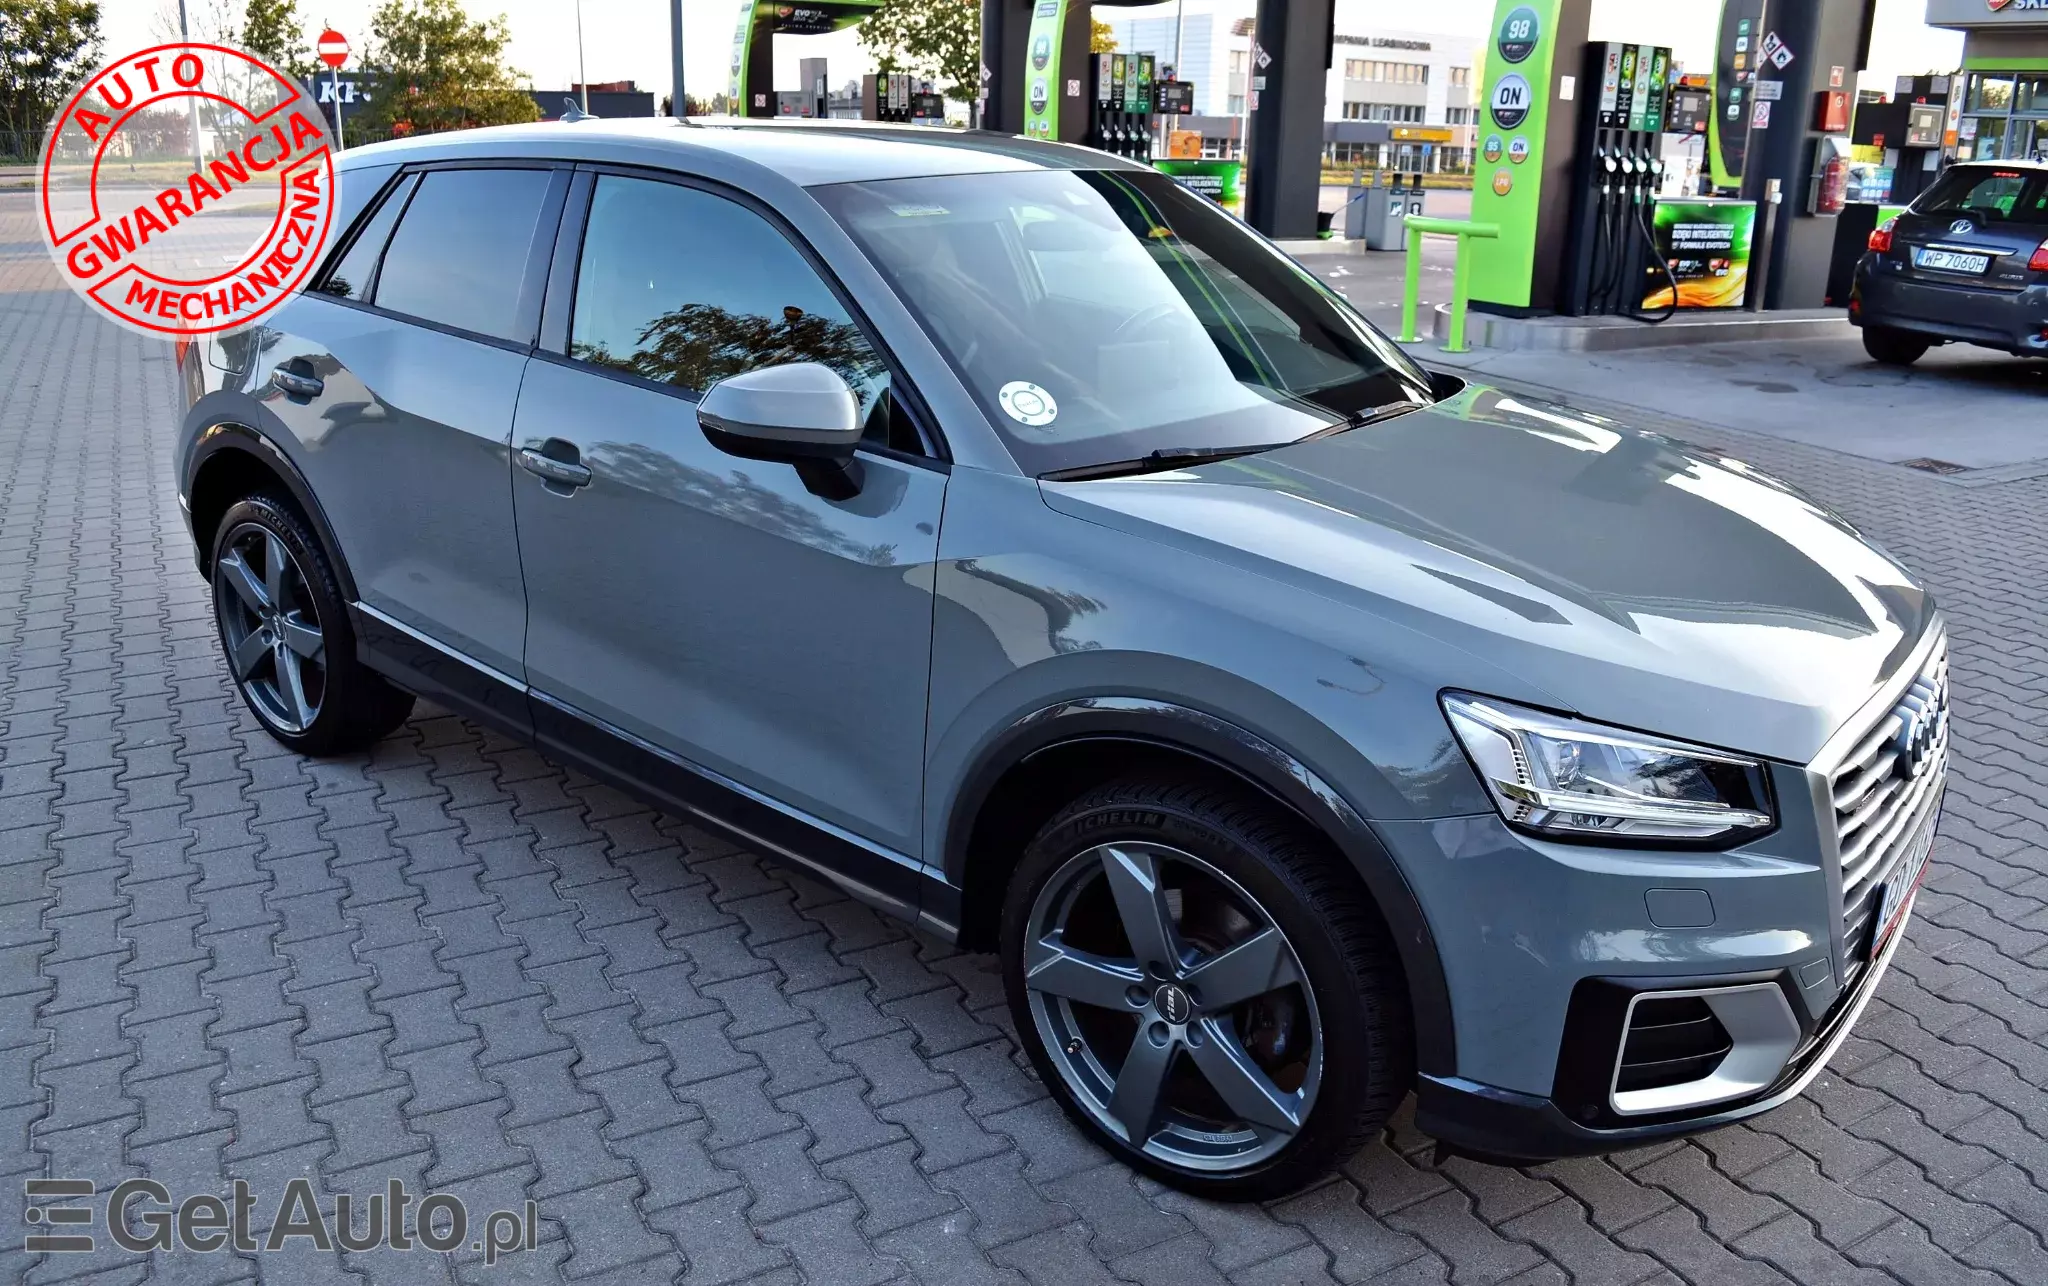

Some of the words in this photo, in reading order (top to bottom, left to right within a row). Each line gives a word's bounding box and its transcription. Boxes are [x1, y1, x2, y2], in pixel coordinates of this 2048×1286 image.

[1508, 20, 1530, 39] 98
[1033, 86, 1043, 98] ON
[1500, 87, 1521, 105] ON
[1513, 142, 1525, 152] ON
[1924, 252, 1943, 267] WP
[1945, 254, 1986, 272] 7060H
